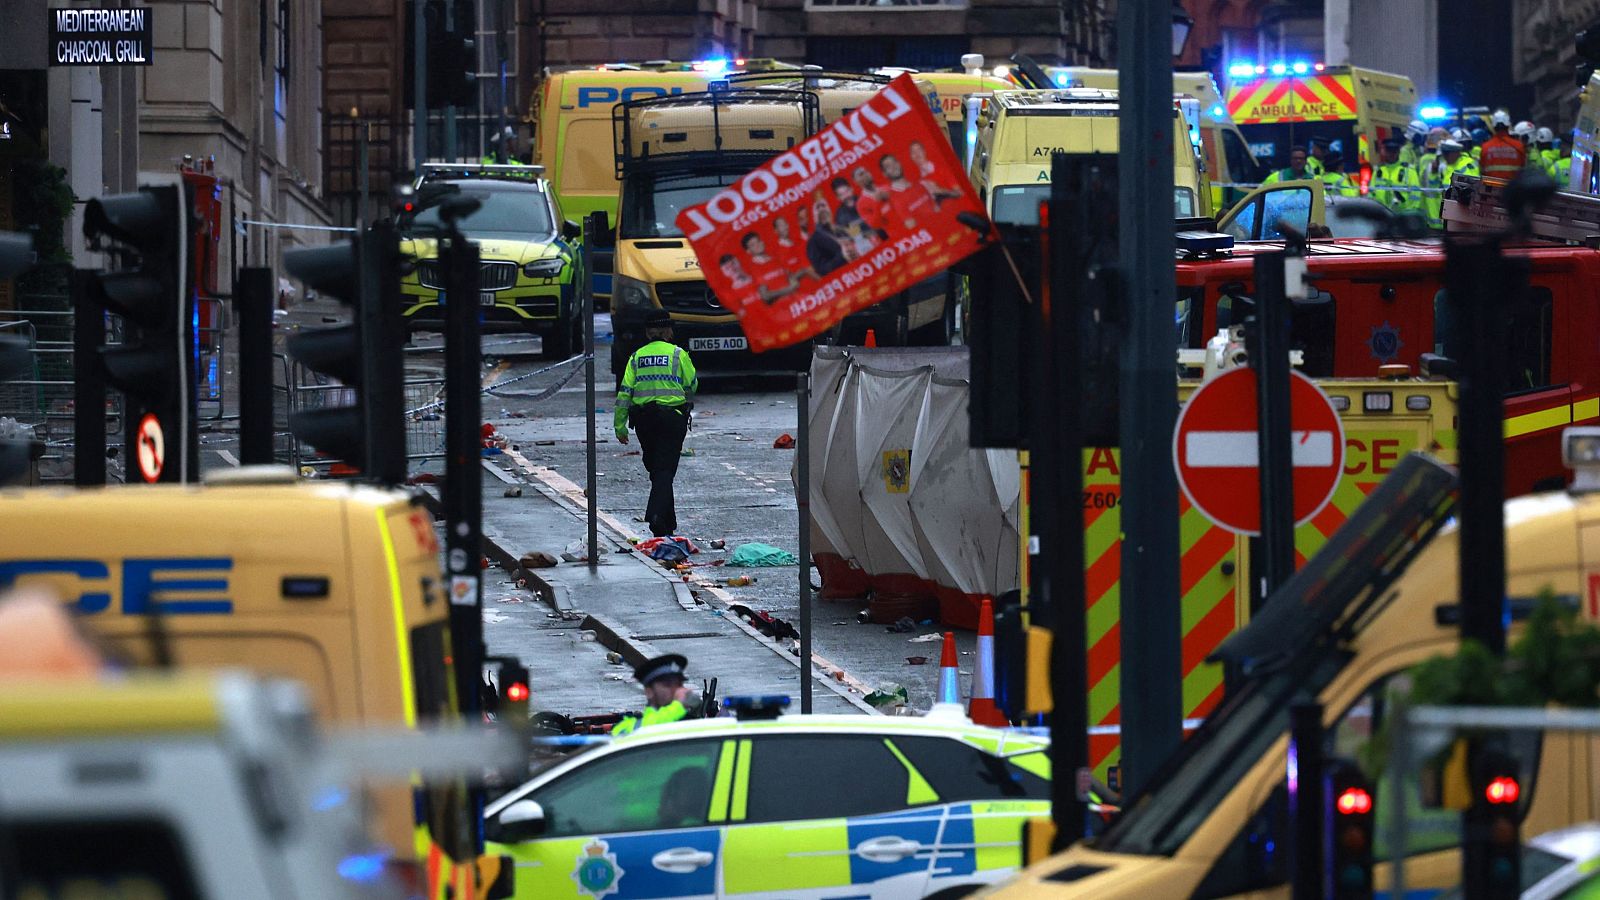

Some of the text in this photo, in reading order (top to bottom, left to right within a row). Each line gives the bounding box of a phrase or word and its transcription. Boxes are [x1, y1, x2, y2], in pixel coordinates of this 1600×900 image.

[56, 9, 144, 32] MEDITERRANEAN
[57, 40, 146, 63] CHARCOAL GRILL
[1251, 102, 1338, 117] AMBULANCE
[693, 339, 721, 350] DK65
[639, 356, 668, 366] POLICE
[1082, 492, 1121, 509] Z60
